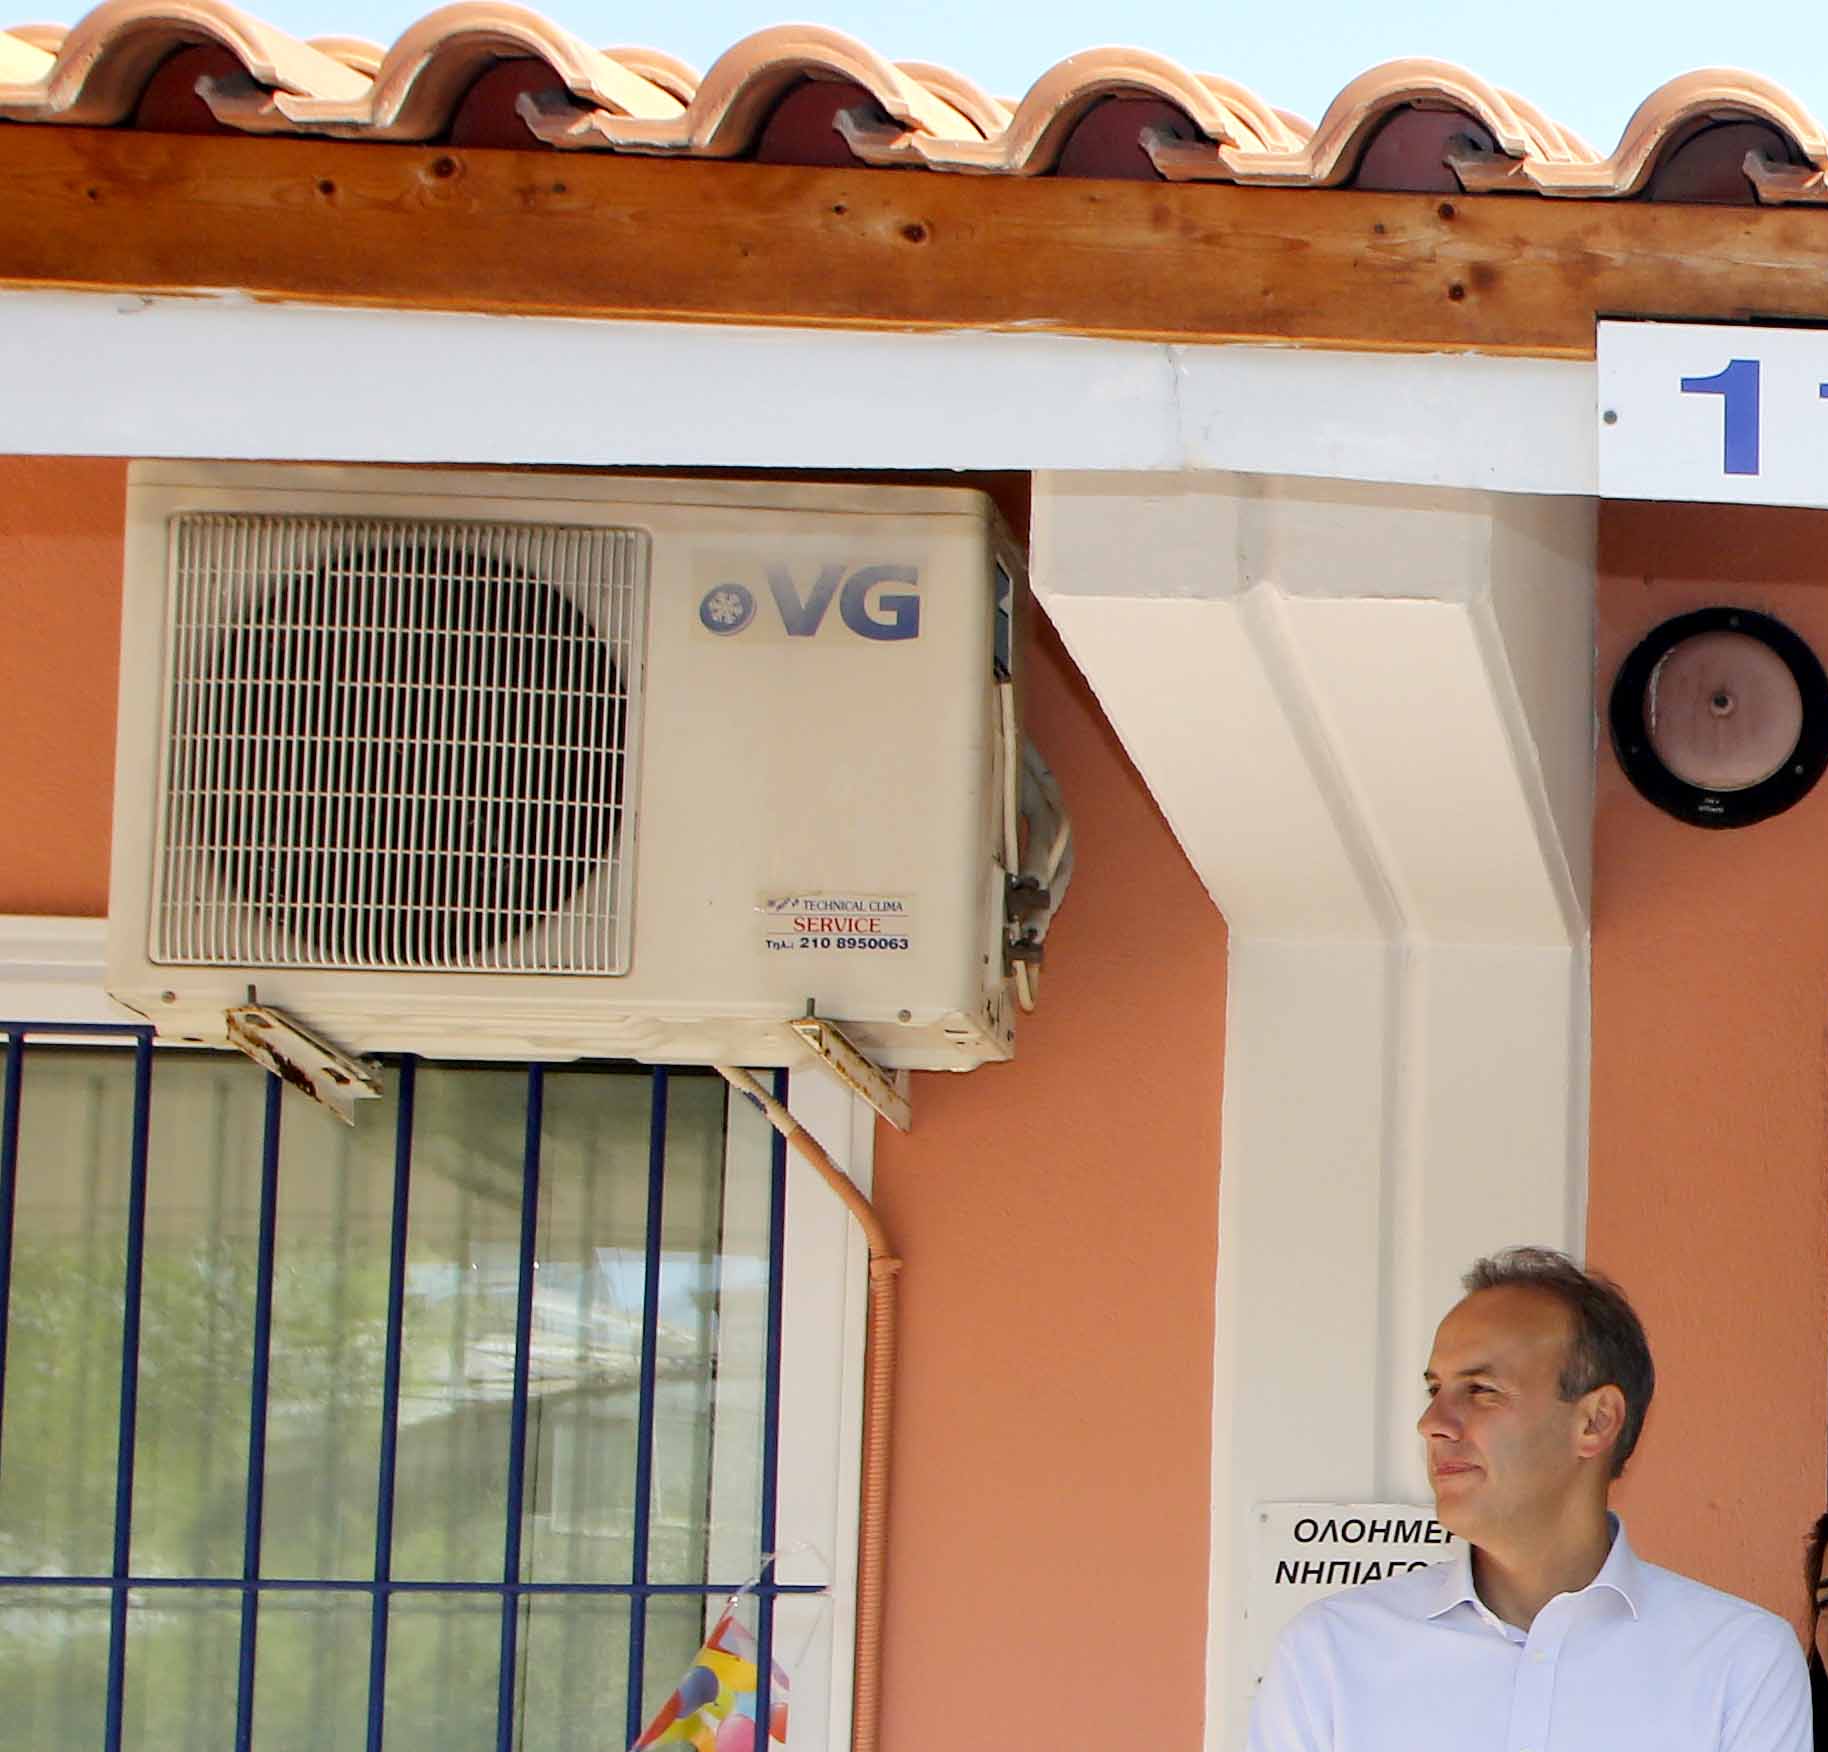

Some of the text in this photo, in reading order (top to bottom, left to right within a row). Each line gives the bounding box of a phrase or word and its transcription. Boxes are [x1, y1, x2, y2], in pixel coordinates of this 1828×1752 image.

[766, 565, 921, 642] VG
[804, 900, 904, 912] TECHNICAL CLIMA
[793, 916, 881, 933] SERVICE
[800, 937, 831, 949] 210
[836, 938, 909, 950] 8950063
